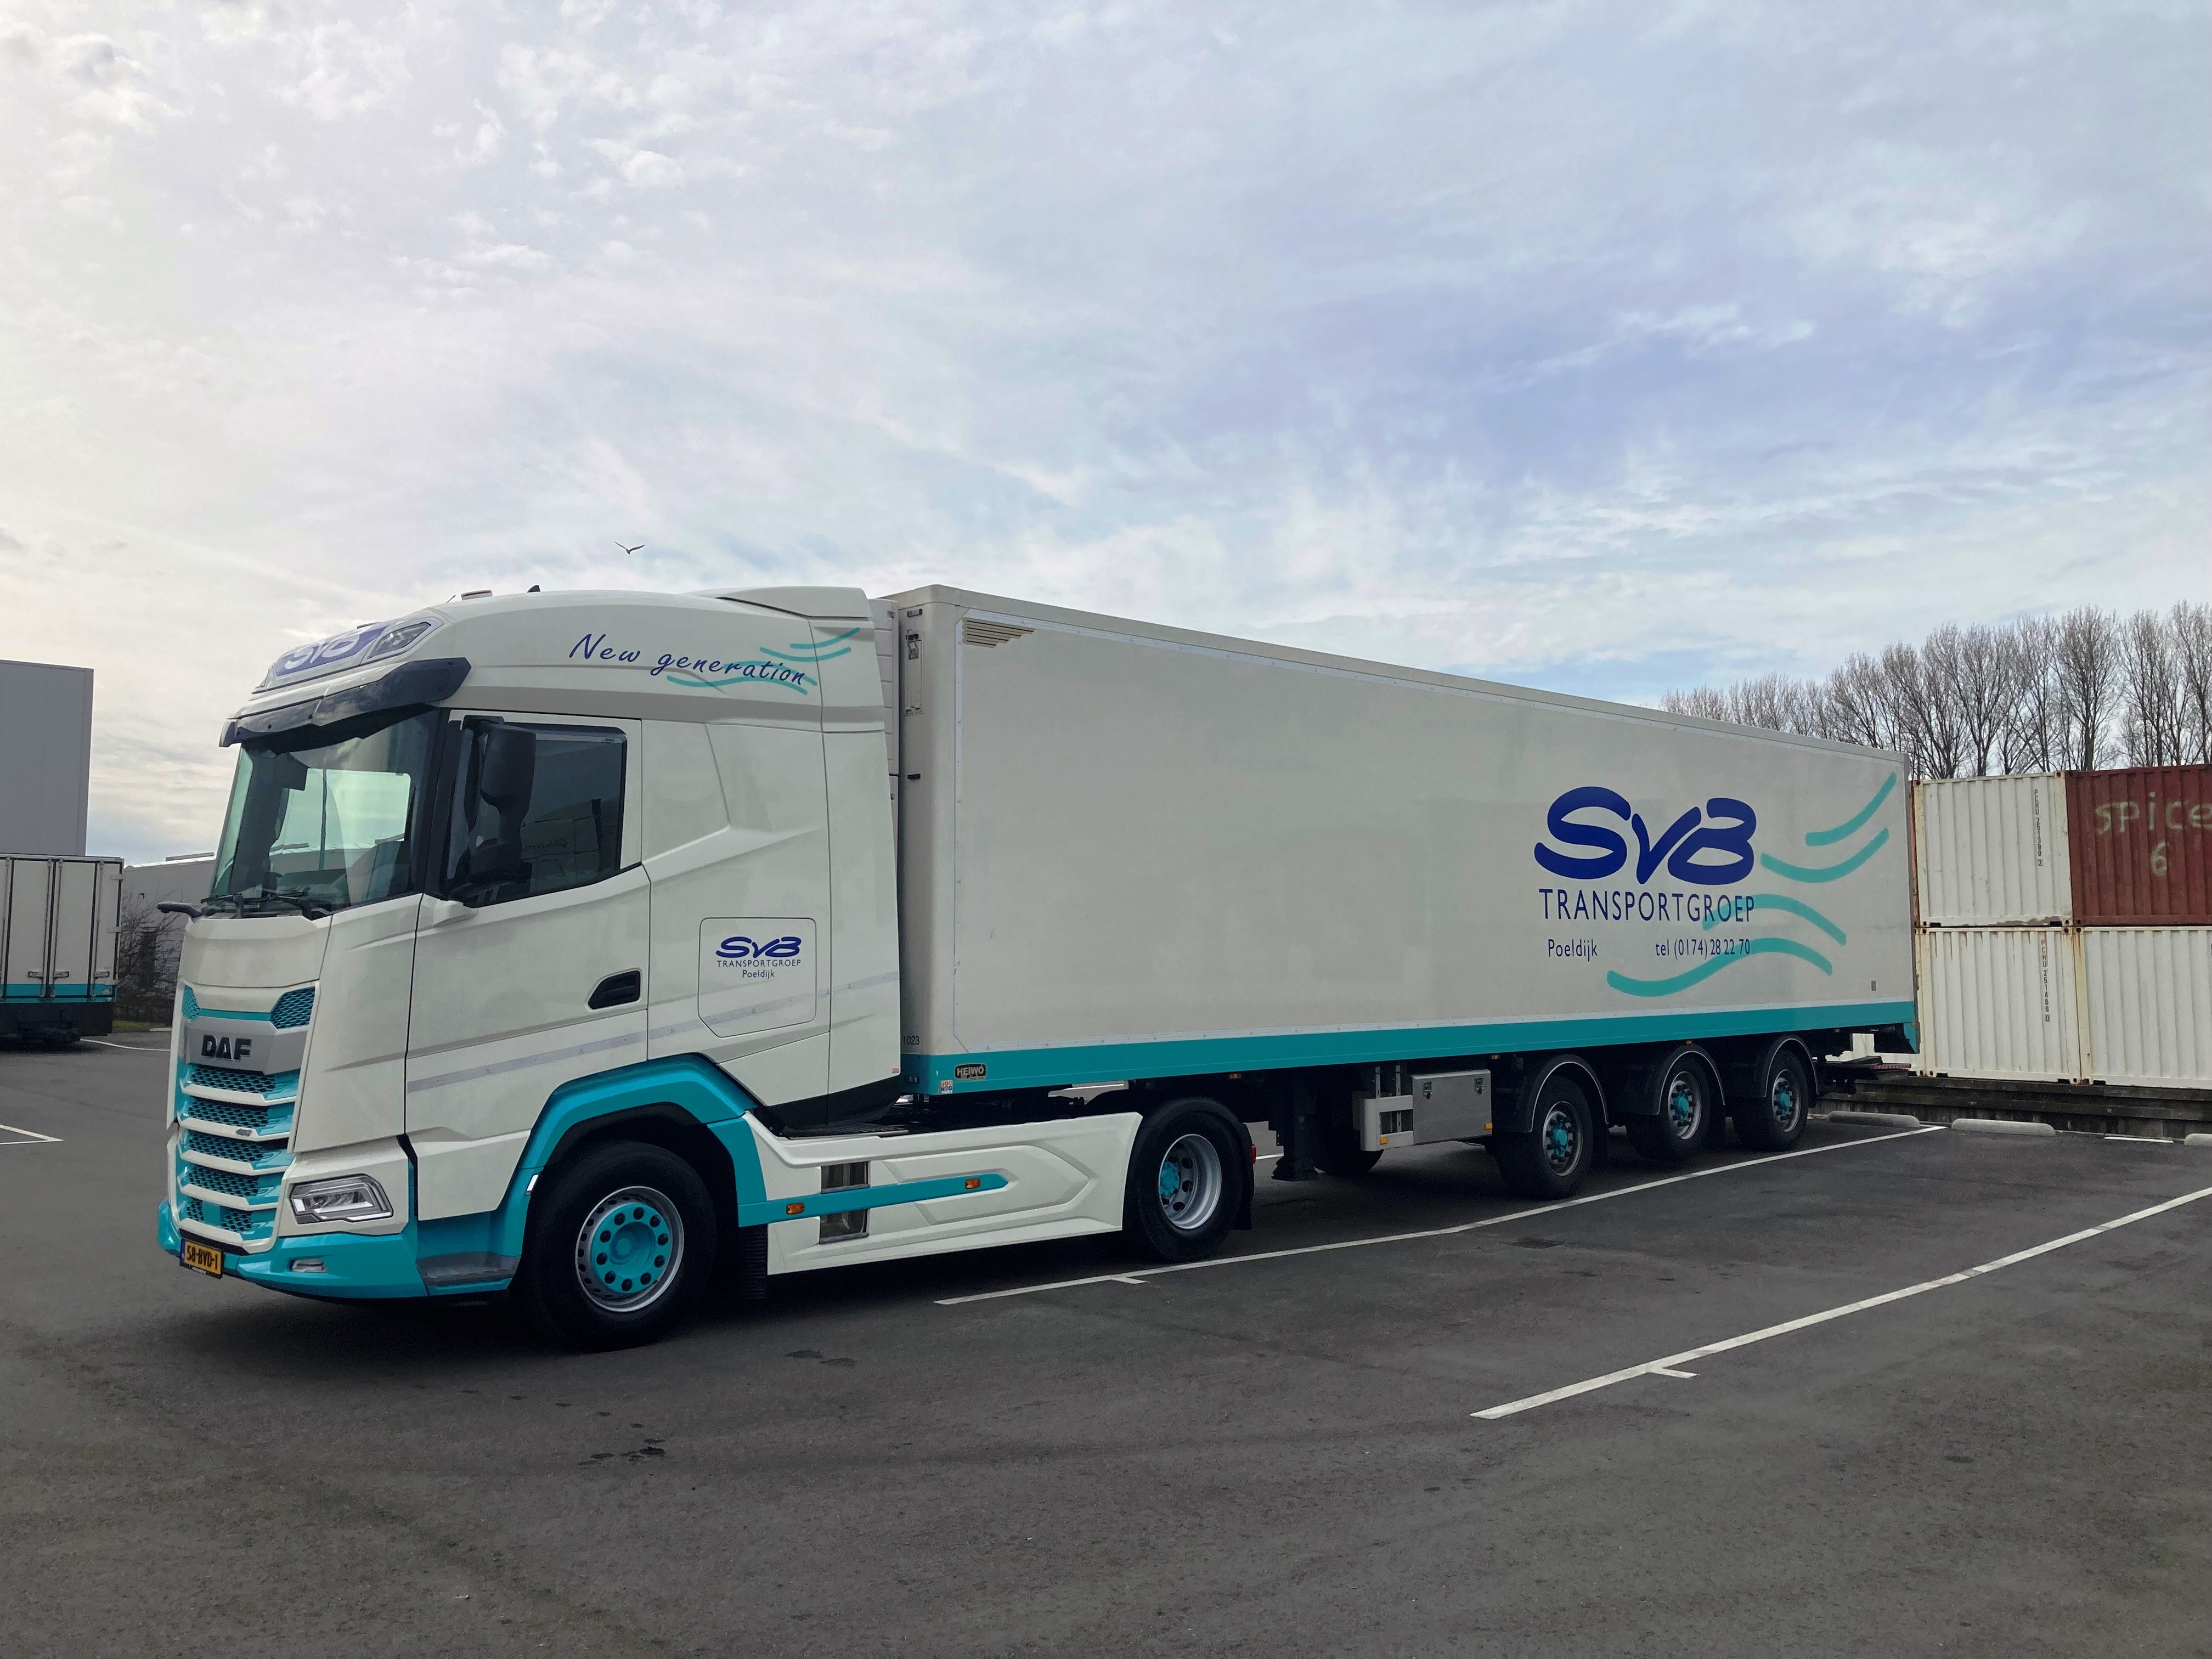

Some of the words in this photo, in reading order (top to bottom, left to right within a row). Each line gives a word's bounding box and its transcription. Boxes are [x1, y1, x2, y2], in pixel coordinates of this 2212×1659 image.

[569, 633, 641, 662] New
[650, 652, 805, 685] generation
[1534, 786, 1757, 885] SVB
[2150, 842, 2167, 876] 6
[1538, 888, 1754, 922] TRANSPORTGROEP
[715, 936, 802, 959] SVB
[1548, 939, 1598, 962] Poeldijk
[1656, 939, 1669, 956] tel
[1674, 939, 1708, 961] (0174)
[1710, 939, 1721, 955] 28
[1724, 939, 1735, 955] 22
[1739, 939, 1751, 955] 70
[716, 960, 801, 968] TRANSPORTGROEP
[742, 969, 775, 979] Poeldijk
[201, 1034, 252, 1061] DAF
[903, 1035, 920, 1045] 1023
[187, 1245, 218, 1269] 58-BVD-1
